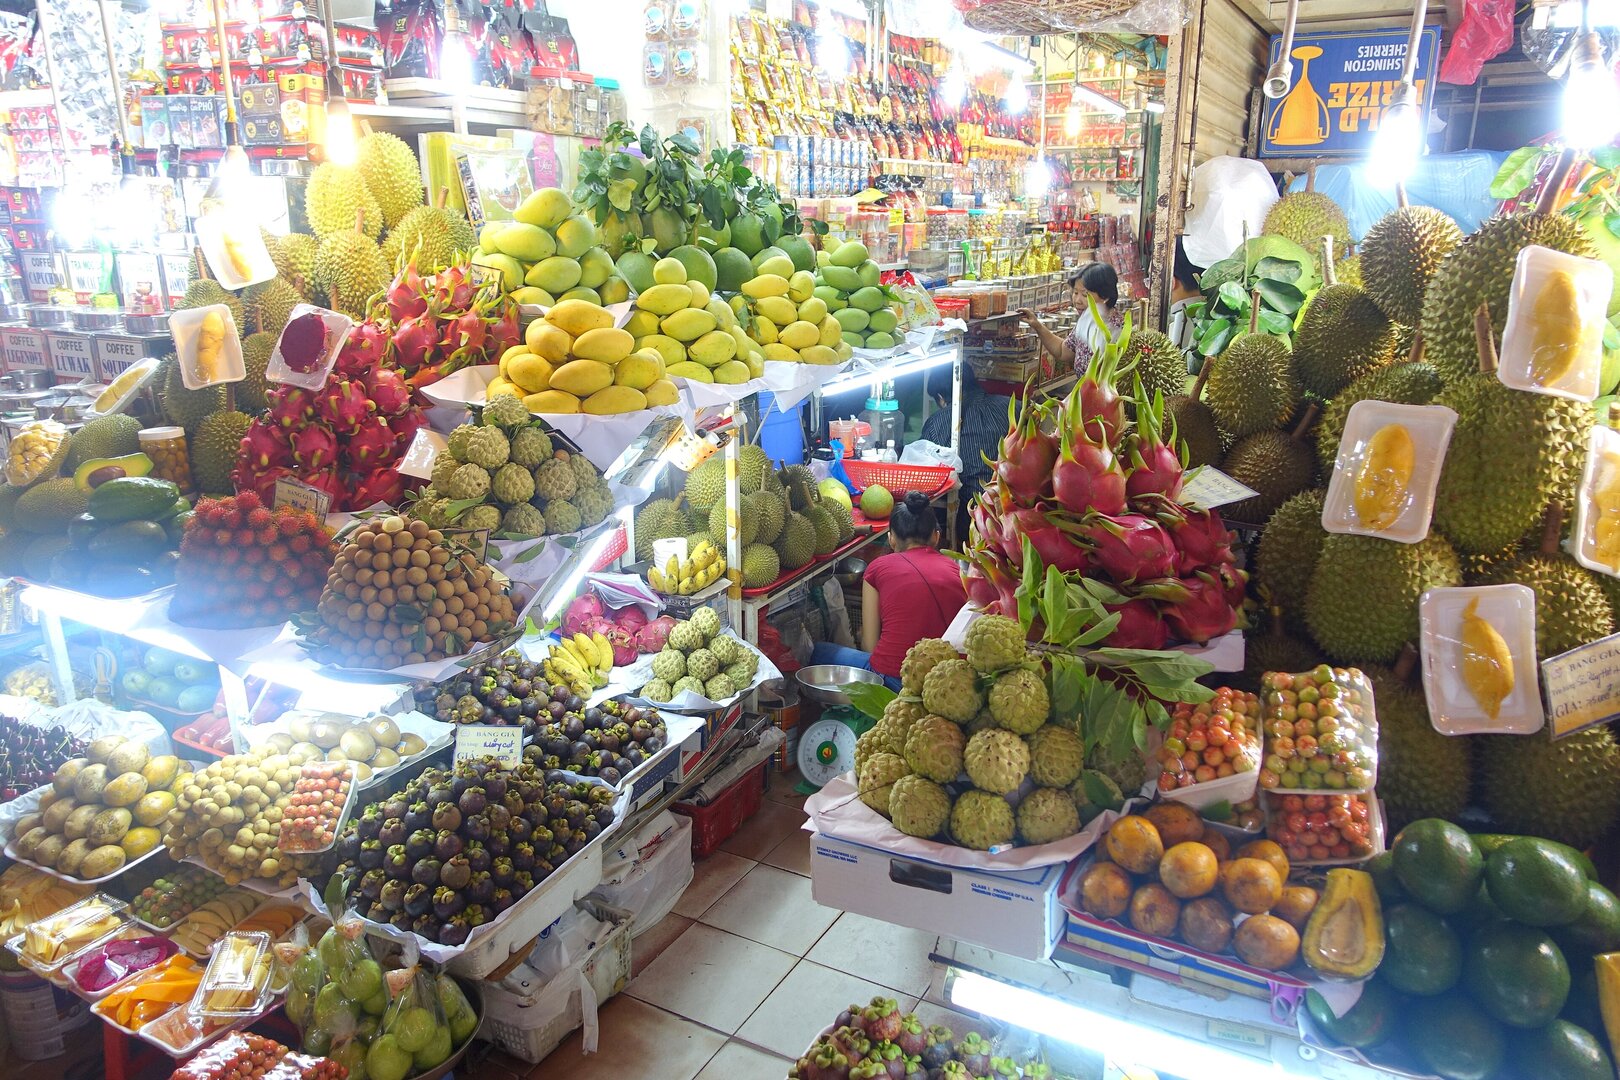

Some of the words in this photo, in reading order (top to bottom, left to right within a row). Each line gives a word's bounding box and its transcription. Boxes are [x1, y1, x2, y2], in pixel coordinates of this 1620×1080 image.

[1358, 44, 1409, 58] CHERRIES
[1344, 57, 1419, 72] SHINGTON
[1339, 106, 1421, 132] LD
[31, 257, 52, 267] COFFE
[9, 335, 35, 347] COFFEE
[56, 339, 83, 352] COFFEE
[106, 342, 135, 356] COFFEE
